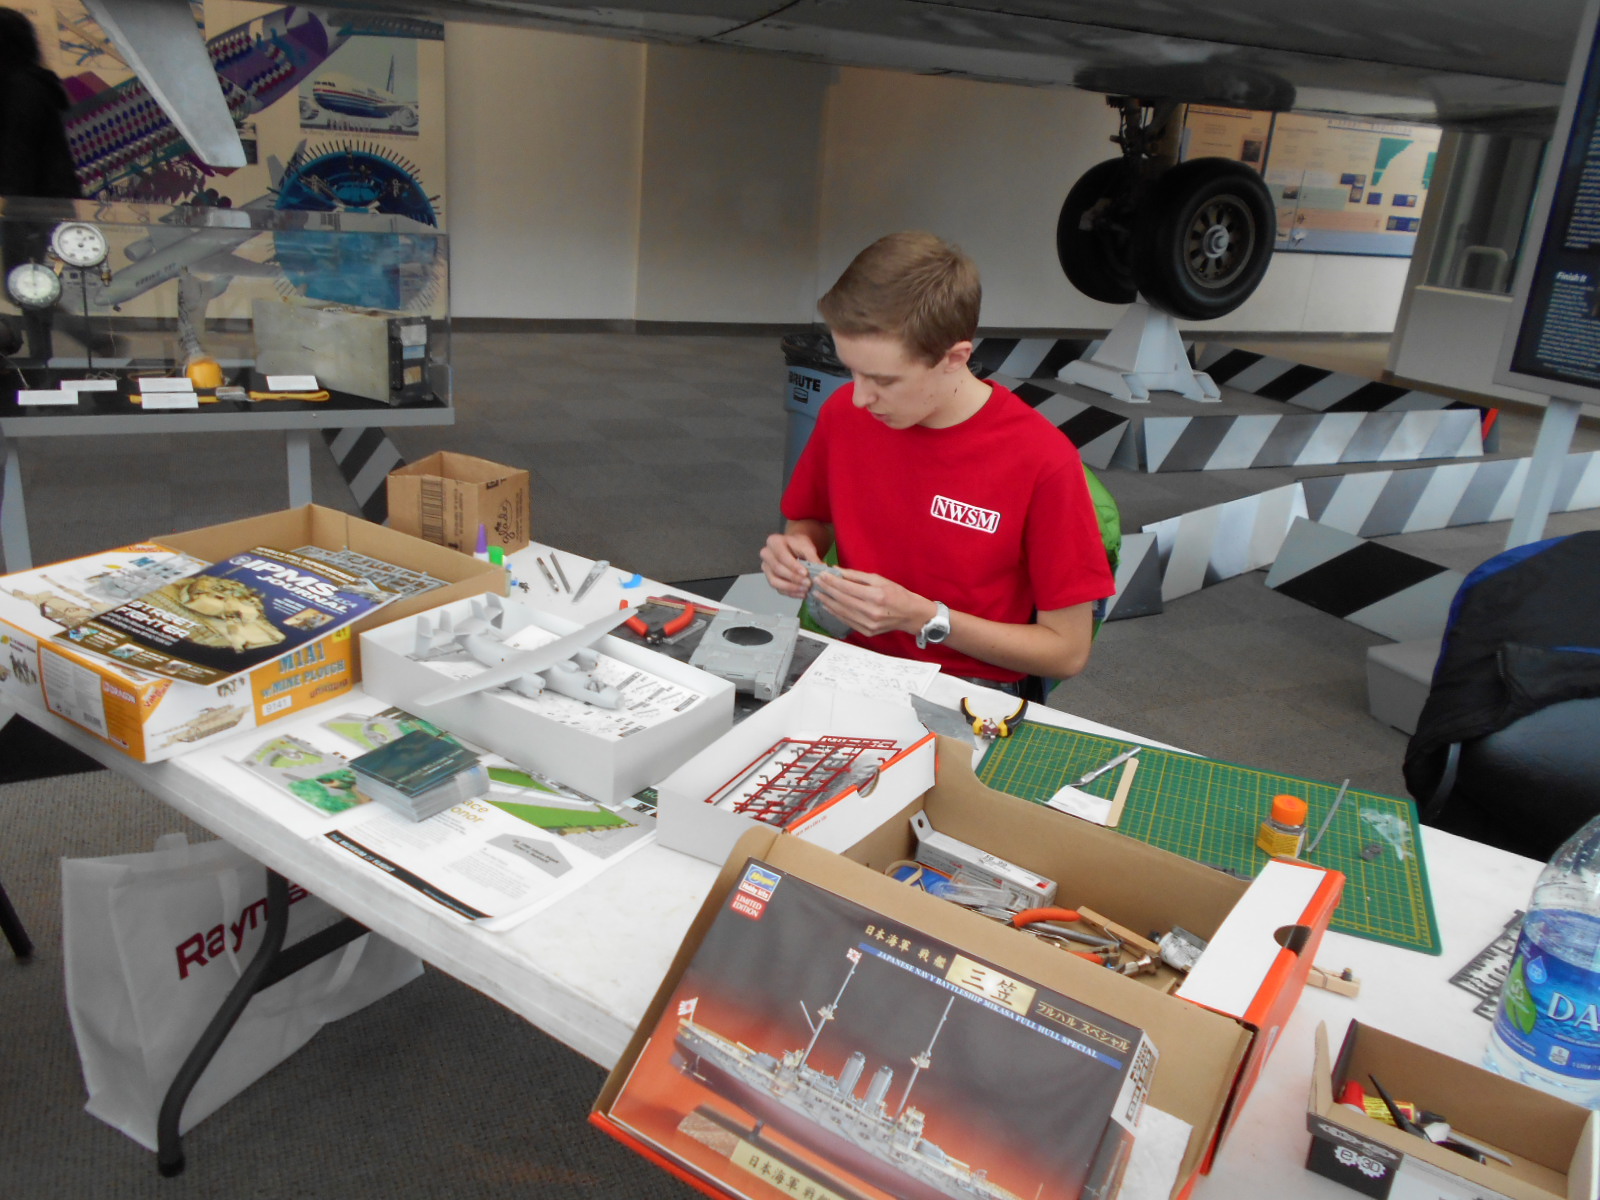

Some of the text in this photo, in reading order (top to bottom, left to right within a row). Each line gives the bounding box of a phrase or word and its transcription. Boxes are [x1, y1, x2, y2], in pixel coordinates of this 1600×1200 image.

[1555, 271, 1580, 281] Finish
[933, 498, 998, 531] NWSM
[242, 559, 339, 597] IPMS
[256, 575, 348, 614] JOURNAL
[114, 606, 191, 640] FIGHTER
[127, 600, 201, 629] STREET
[450, 806, 485, 823] onor
[462, 800, 489, 812] ace
[732, 900, 759, 917] EDITION
[736, 893, 762, 910] LIMITED
[961, 968, 1017, 1006] 三笠
[876, 951, 1098, 1059] JAPANESE NAVY BATTLESHIP MIKASA FULL HULL SPECIAL
